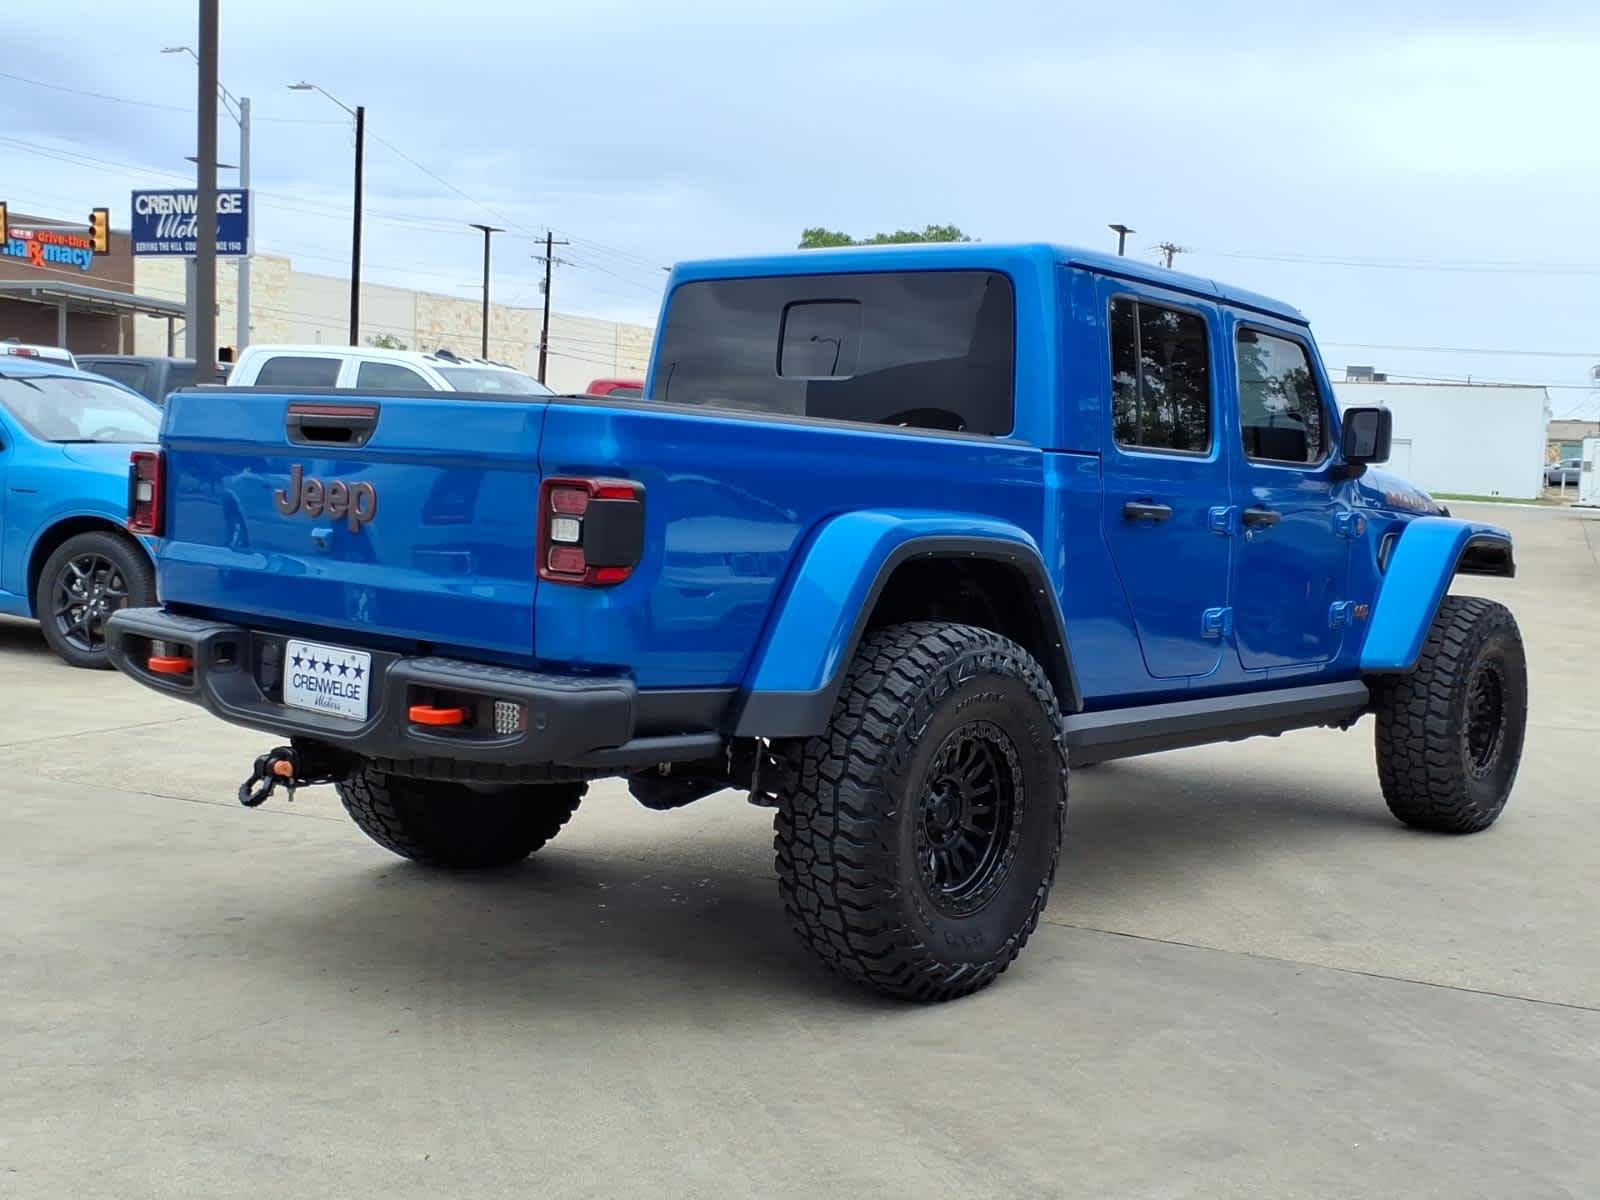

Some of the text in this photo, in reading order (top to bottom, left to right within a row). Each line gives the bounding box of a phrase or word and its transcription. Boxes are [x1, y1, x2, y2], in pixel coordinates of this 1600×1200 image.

[135, 193, 242, 215] CRENWGE
[159, 242, 170, 251] THE
[275, 464, 377, 533] Jeep
[292, 672, 362, 701] CRENWELGE
